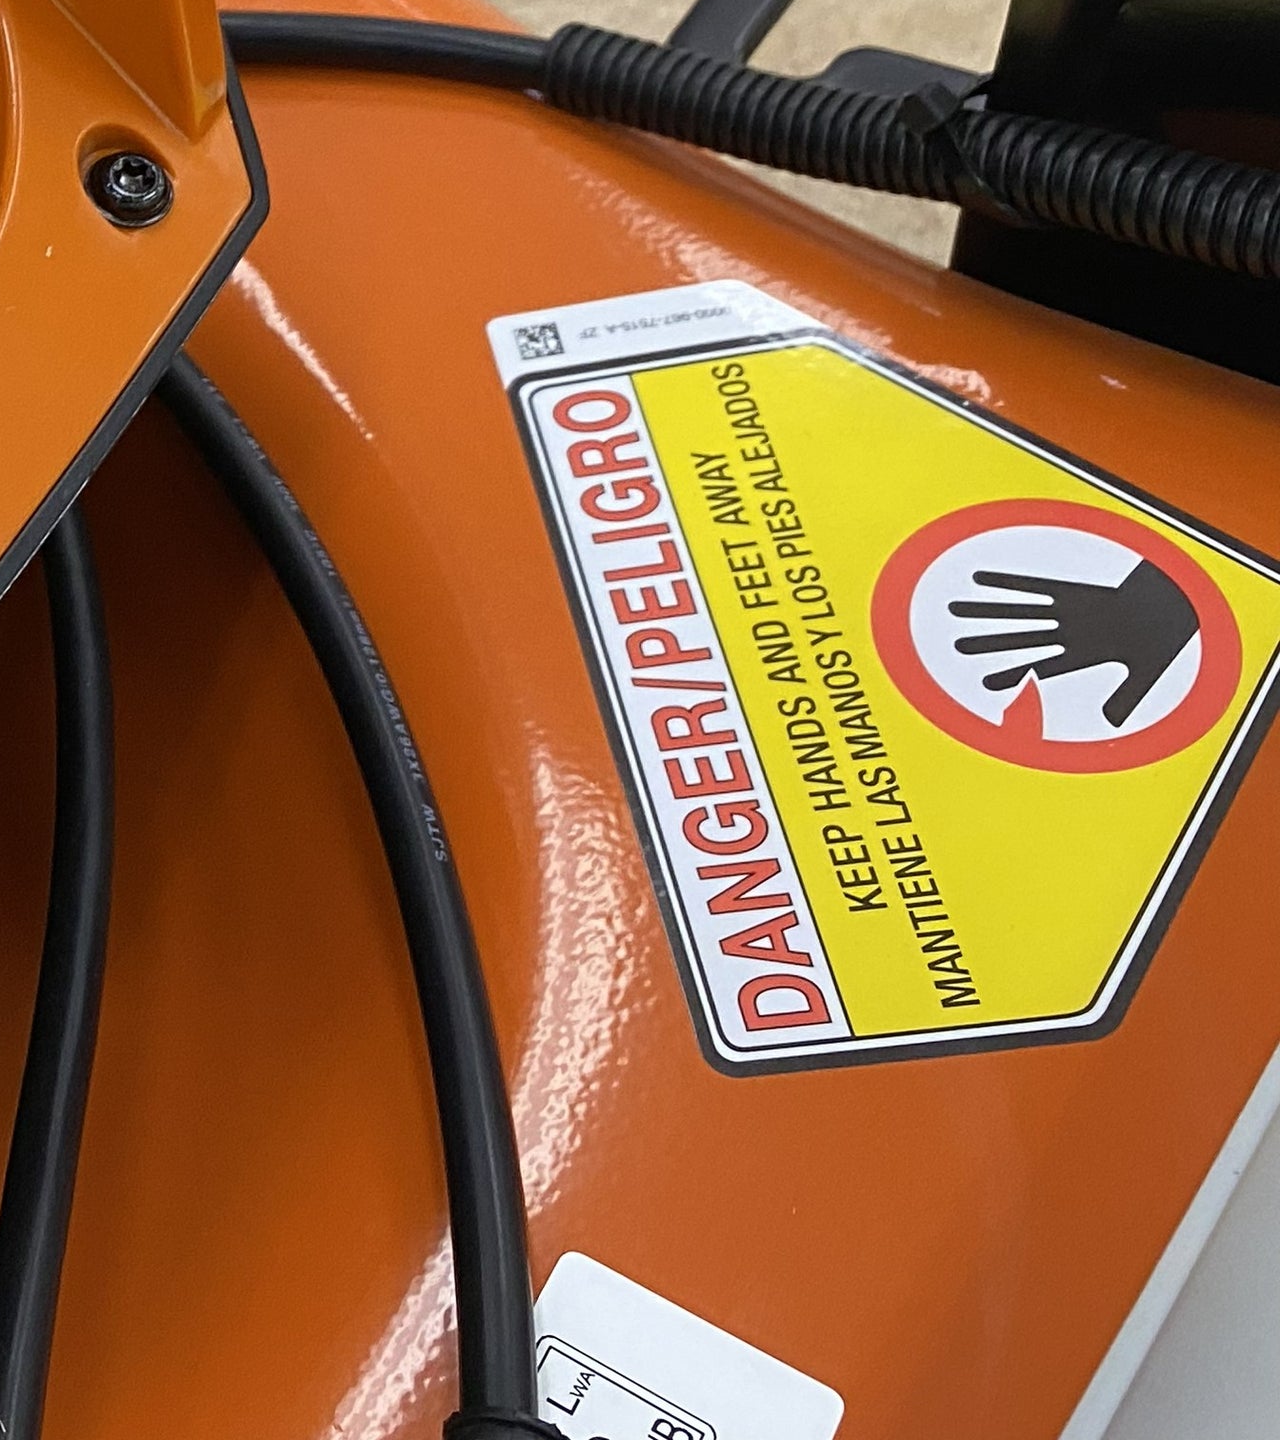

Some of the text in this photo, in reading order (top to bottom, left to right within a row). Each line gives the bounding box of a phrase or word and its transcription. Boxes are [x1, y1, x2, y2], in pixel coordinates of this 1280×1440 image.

[421, 804, 449, 862] SJTW
[552, 389, 833, 1032] DANGER/PELIGRO
[690, 452, 889, 912] KEEP HANDS AND FEET AWAY
[711, 362, 981, 1009] MANTIENE LAS MANOS Y LOS PIES ALEJADOS
